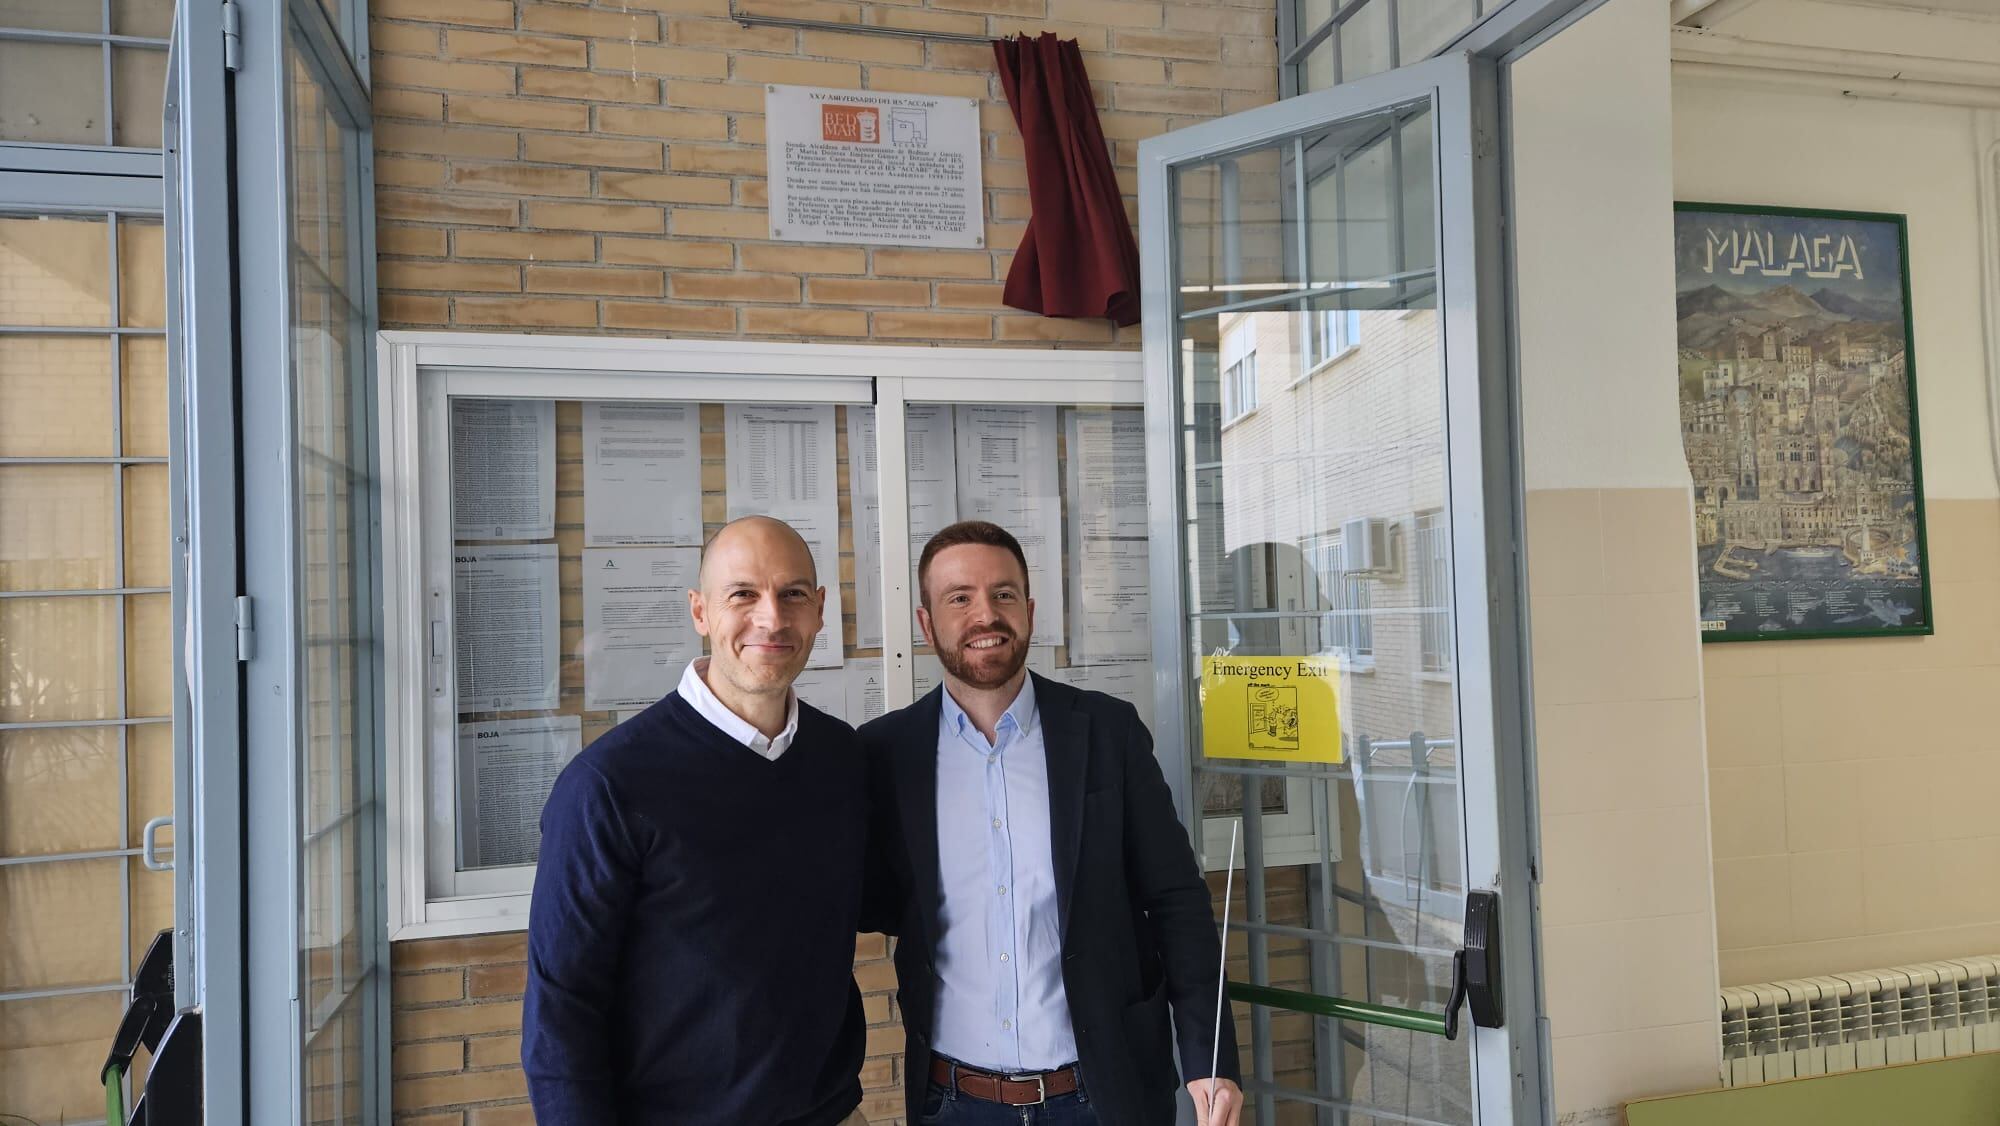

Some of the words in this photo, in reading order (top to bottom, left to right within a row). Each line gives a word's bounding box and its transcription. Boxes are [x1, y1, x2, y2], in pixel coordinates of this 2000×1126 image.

[828, 94, 877, 103] ANIVERSARIO
[824, 112, 857, 126] BED
[825, 124, 857, 137] MAR
[1703, 227, 1864, 280] MALAGA
[1212, 661, 1292, 680] Emergency
[1296, 662, 1328, 676] Exit
